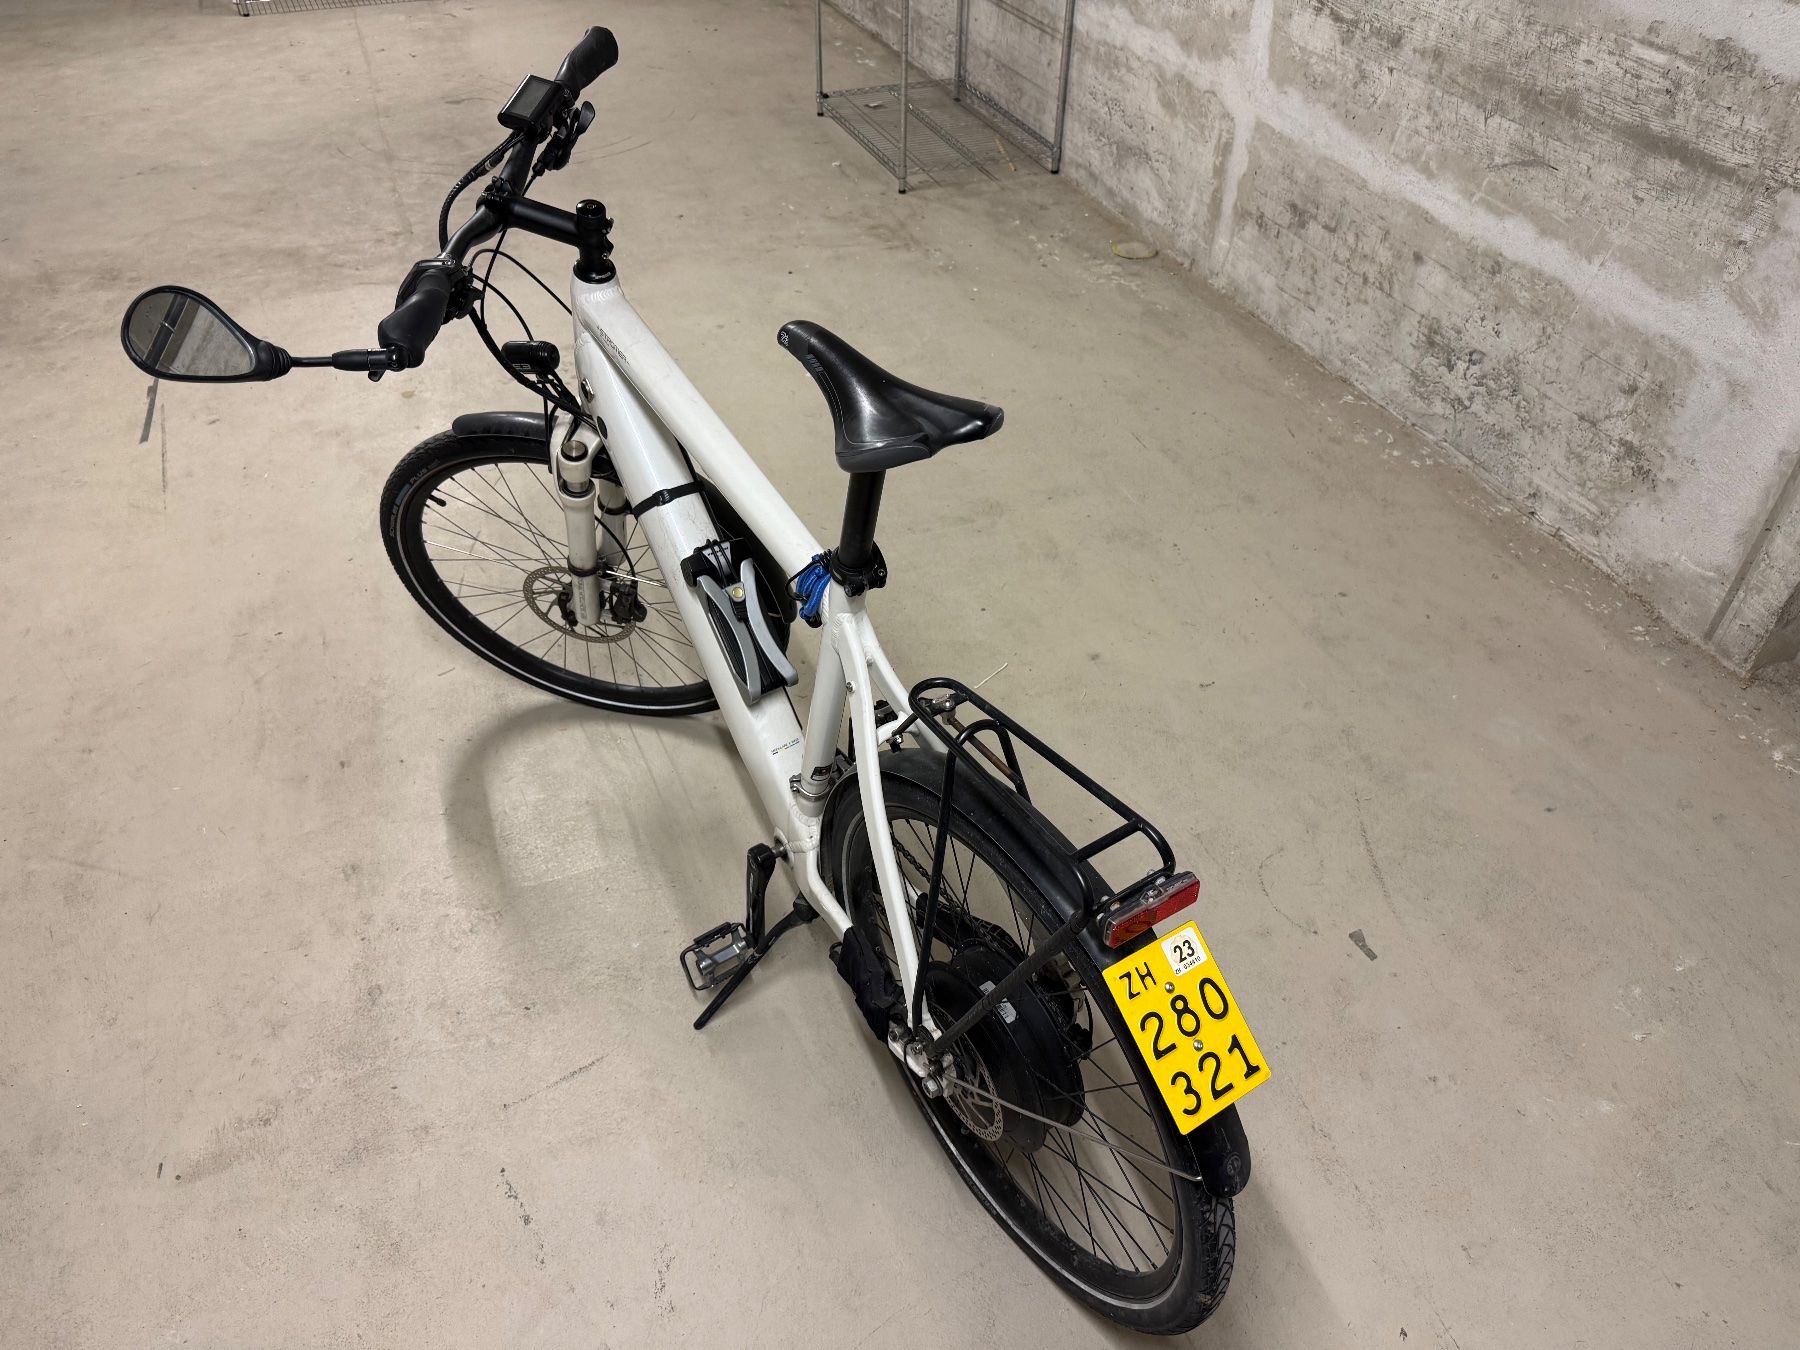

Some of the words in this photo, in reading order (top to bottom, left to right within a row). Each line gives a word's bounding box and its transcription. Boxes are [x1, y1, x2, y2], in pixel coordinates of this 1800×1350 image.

[1173, 939, 1195, 963] 23
[1119, 962, 1157, 1000] ZH
[1140, 977, 1229, 1061] 280
[1171, 1035, 1261, 1116] 321
